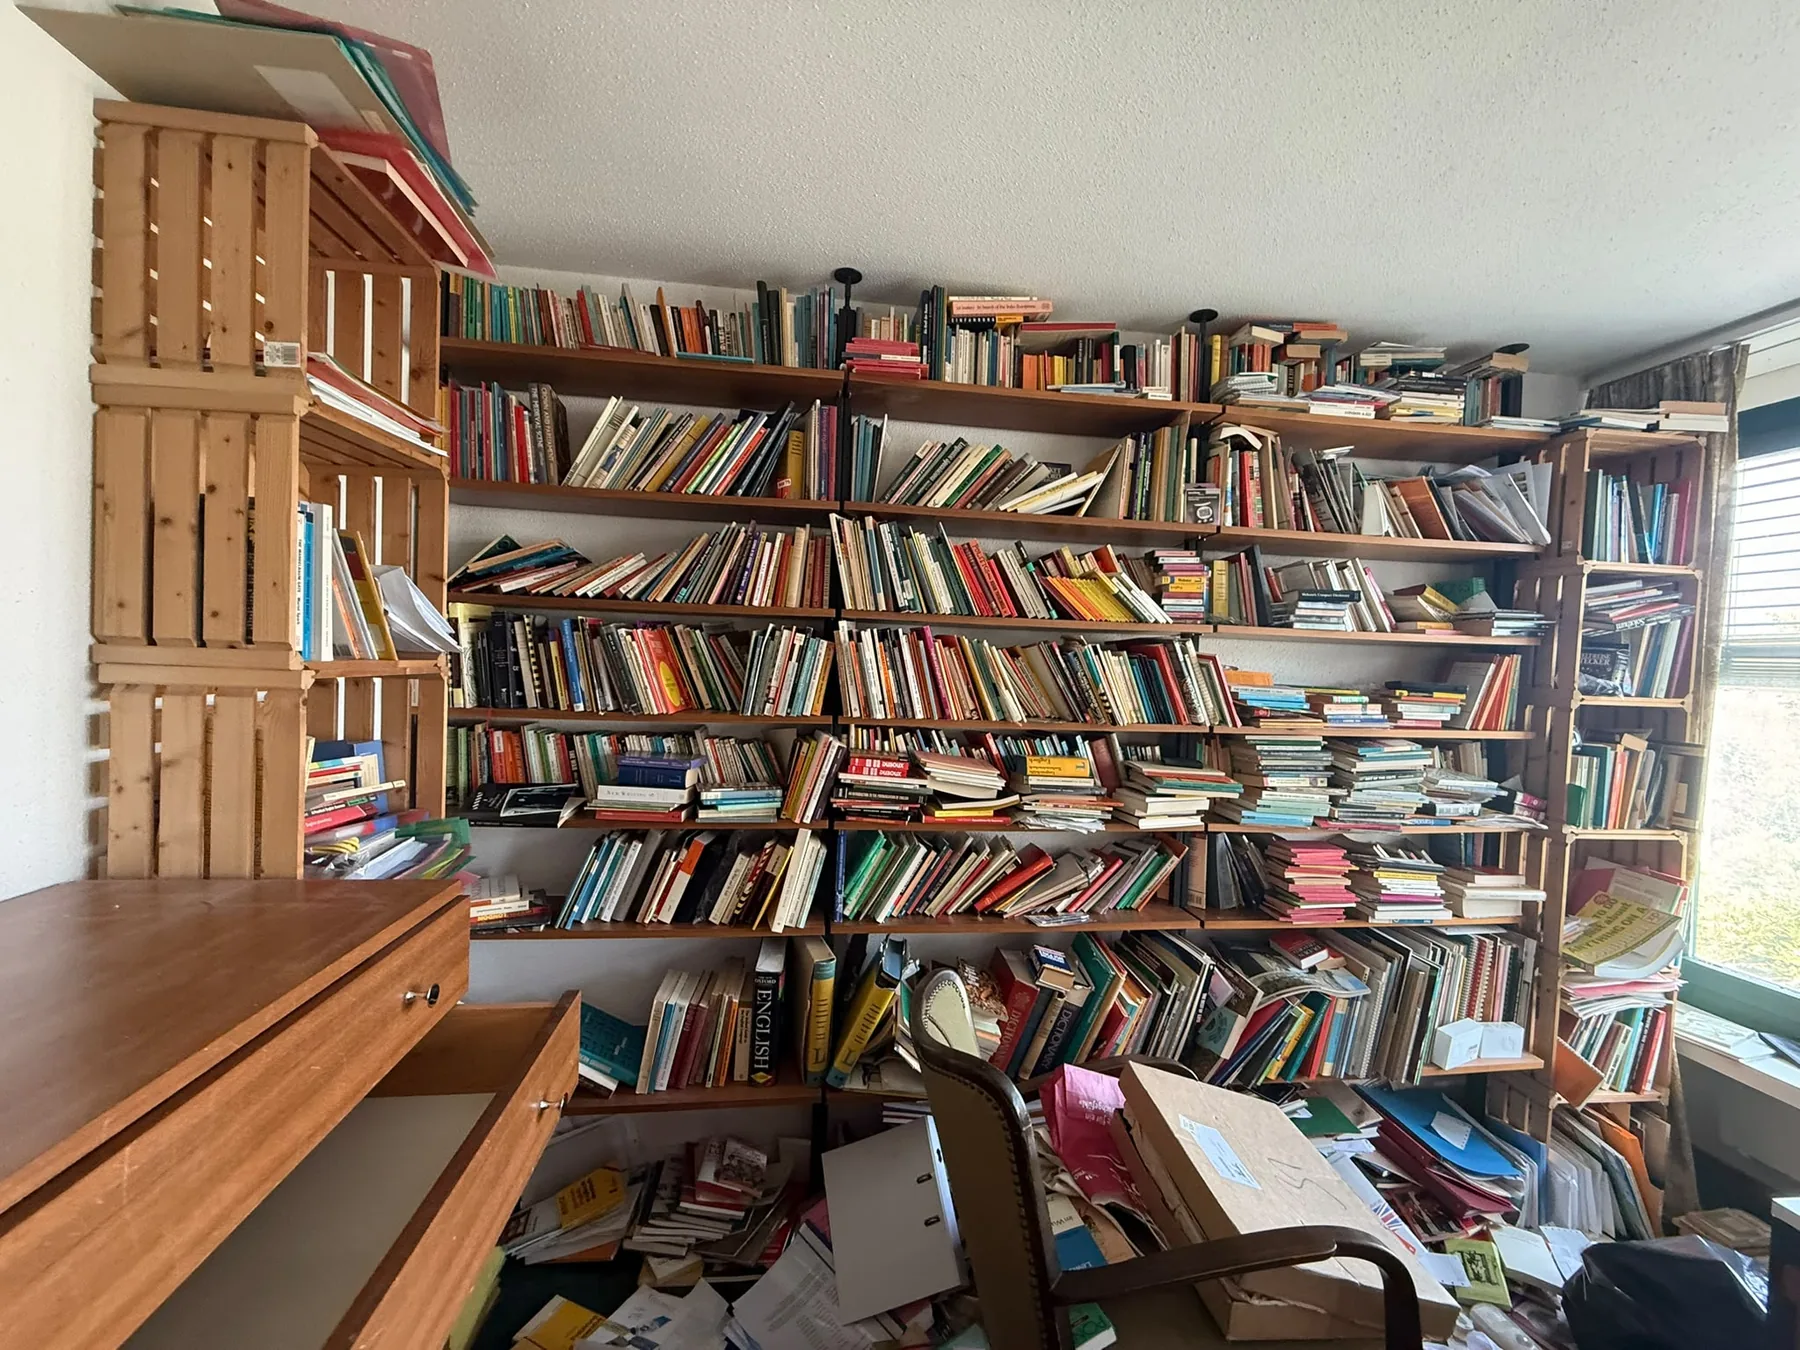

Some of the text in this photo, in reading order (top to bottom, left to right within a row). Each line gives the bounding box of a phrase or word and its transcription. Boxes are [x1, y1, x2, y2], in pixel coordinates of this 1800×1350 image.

[530, 386, 543, 448] THE MEDIEVAL SCENE
[540, 386, 556, 462] CROWN AND PARLIAMENT
[971, 542, 991, 575] POLITICS
[1028, 757, 1051, 765] Englisch
[477, 912, 507, 922] LONDON
[1567, 906, 1648, 954] ANYTHING ON A
[1591, 908, 1606, 920] TO
[1606, 902, 1632, 925] about
[754, 989, 772, 1070] ENGLISH
[1041, 1009, 1073, 1069] DICTIONARY
